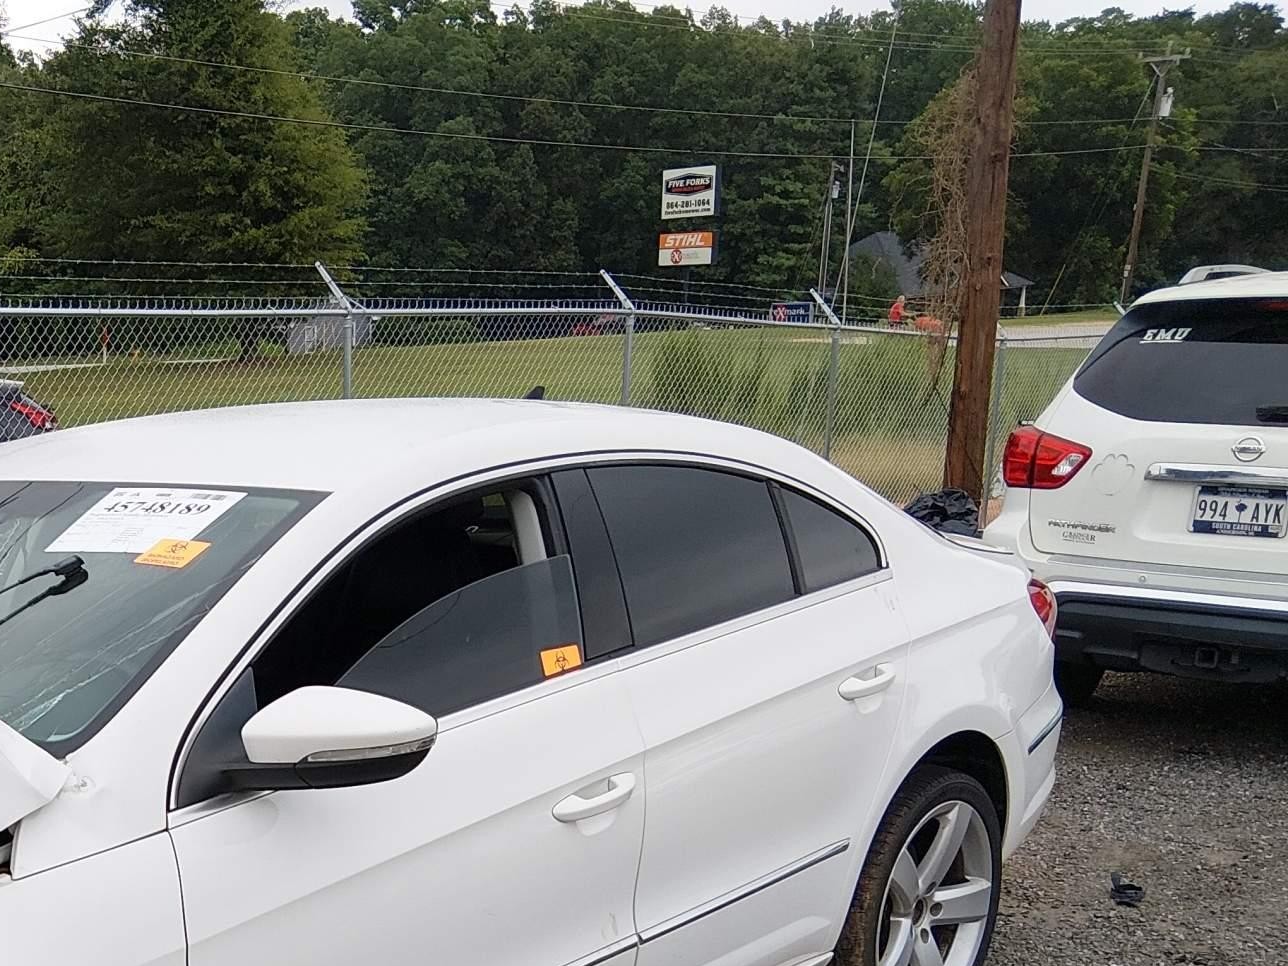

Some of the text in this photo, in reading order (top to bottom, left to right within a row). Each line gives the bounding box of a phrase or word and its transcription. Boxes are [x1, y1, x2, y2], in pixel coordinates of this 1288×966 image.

[668, 177, 711, 188] FIVE FORKS
[666, 199, 710, 210] 864-281-1064
[665, 232, 705, 247] STIHL
[1142, 327, 1192, 341] EMU
[104, 501, 211, 516] 45748189
[1198, 499, 1285, 524] 994 AYK
[1212, 522, 1262, 532] SOUTH CAROLINA
